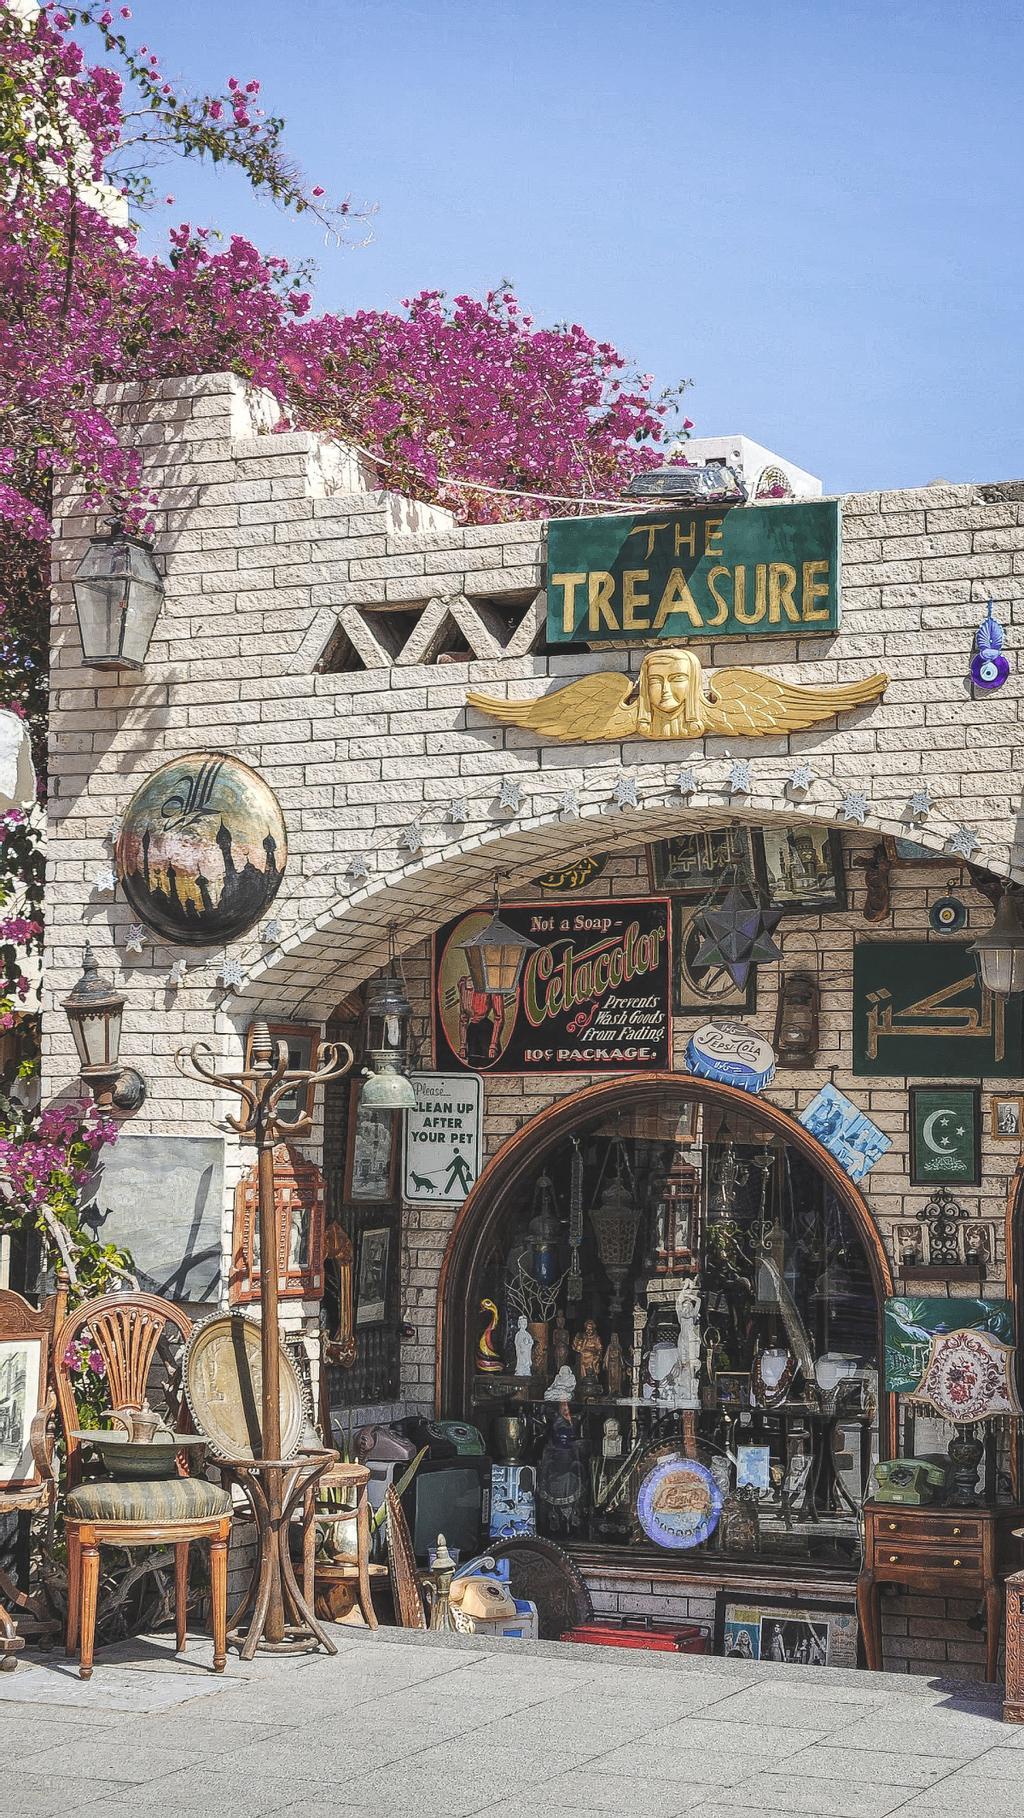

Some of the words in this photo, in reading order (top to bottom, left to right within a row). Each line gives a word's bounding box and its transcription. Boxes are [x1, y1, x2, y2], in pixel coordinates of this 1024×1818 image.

[628, 519, 723, 560] THE
[551, 560, 830, 633] TREASURE
[530, 916, 555, 932] Not
[560, 919, 570, 931] a
[524, 921, 665, 1027] Cetacolor
[603, 994, 661, 1009] Prevents
[594, 1010, 628, 1025] Wash
[629, 1010, 665, 1025] Goods
[581, 1027, 617, 1042] from
[616, 1026, 665, 1043] Fading.
[557, 1047, 657, 1062] PACKAGE.
[457, 1103, 474, 1113] UP
[423, 1117, 463, 1128] AFTER
[411, 1131, 446, 1142] YOUR
[450, 1133, 474, 1144] PET
